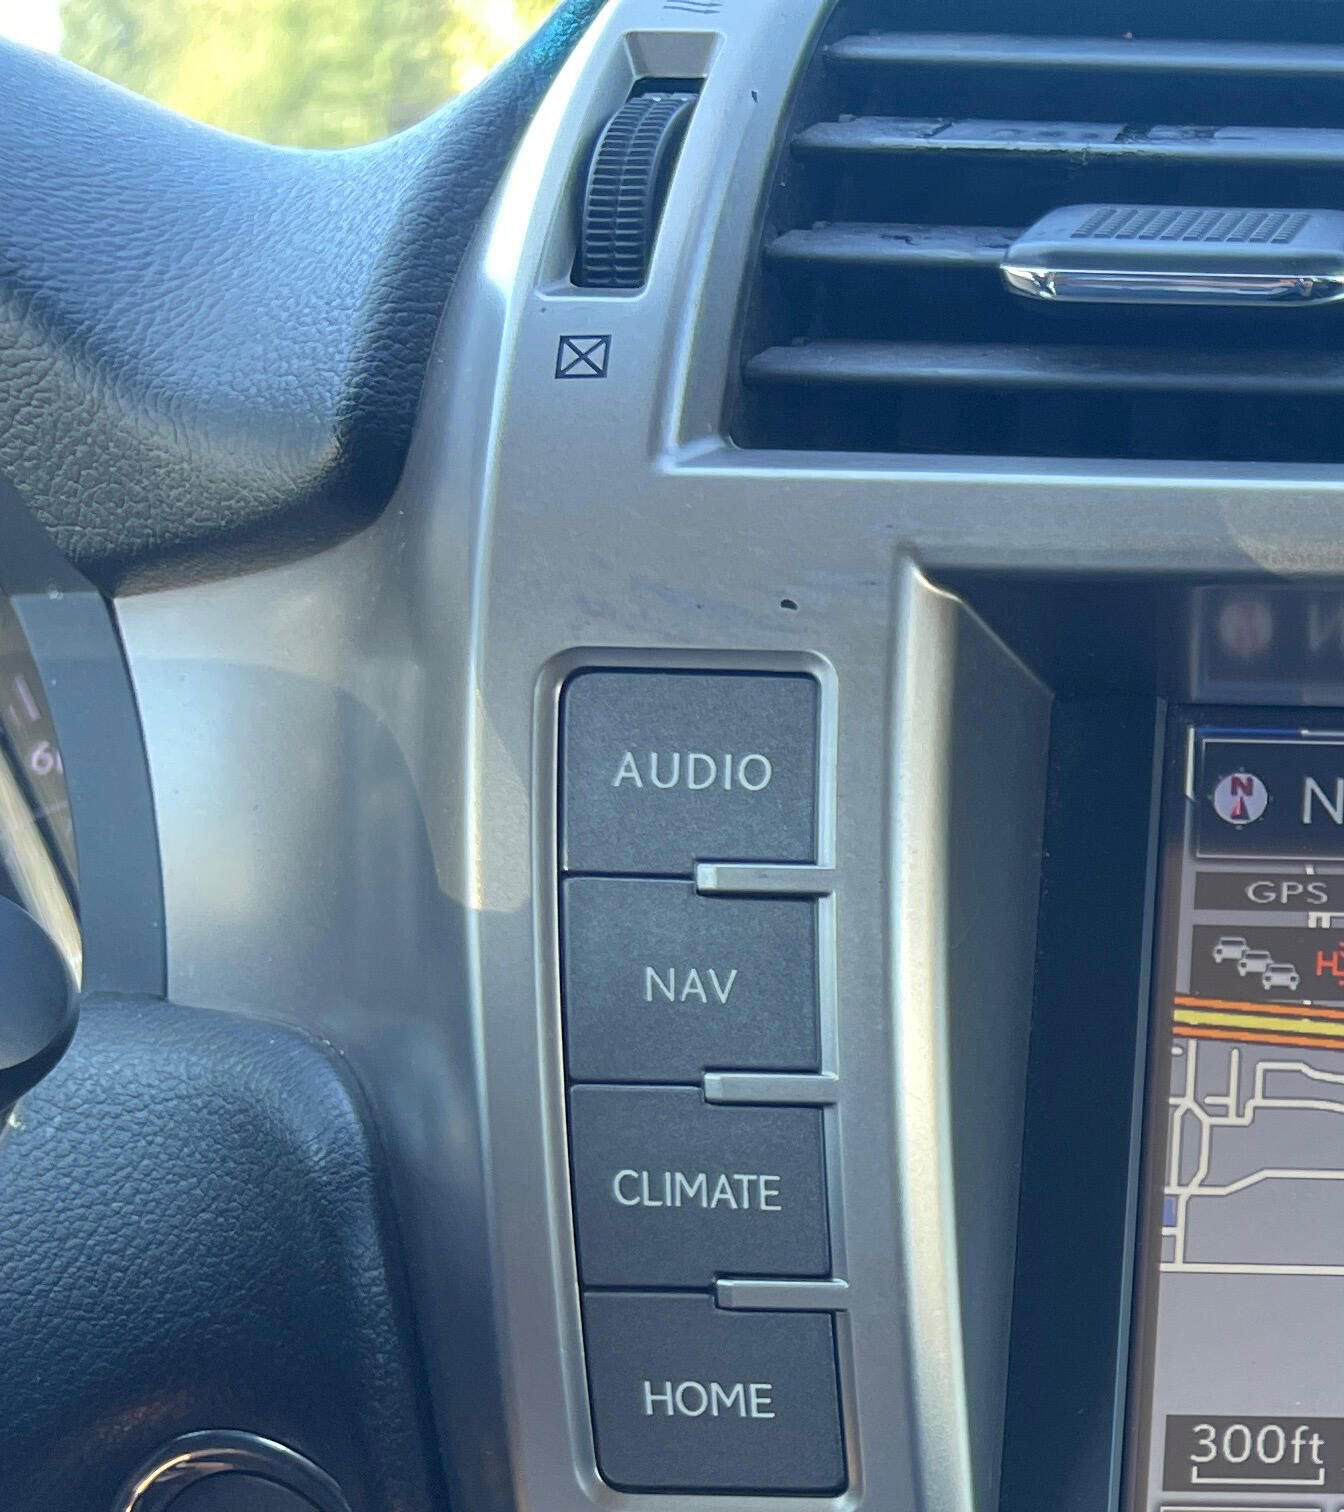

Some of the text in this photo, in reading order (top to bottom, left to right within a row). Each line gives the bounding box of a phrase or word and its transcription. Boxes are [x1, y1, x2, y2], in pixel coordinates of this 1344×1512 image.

[612, 751, 772, 791] AUDIO
[1302, 777, 1344, 825] N
[1245, 880, 1329, 906] GPS
[645, 966, 738, 1004] NAV
[613, 1169, 782, 1211] CLIMATE
[643, 1380, 776, 1419] HOME
[1190, 1423, 1325, 1465] 300ft
